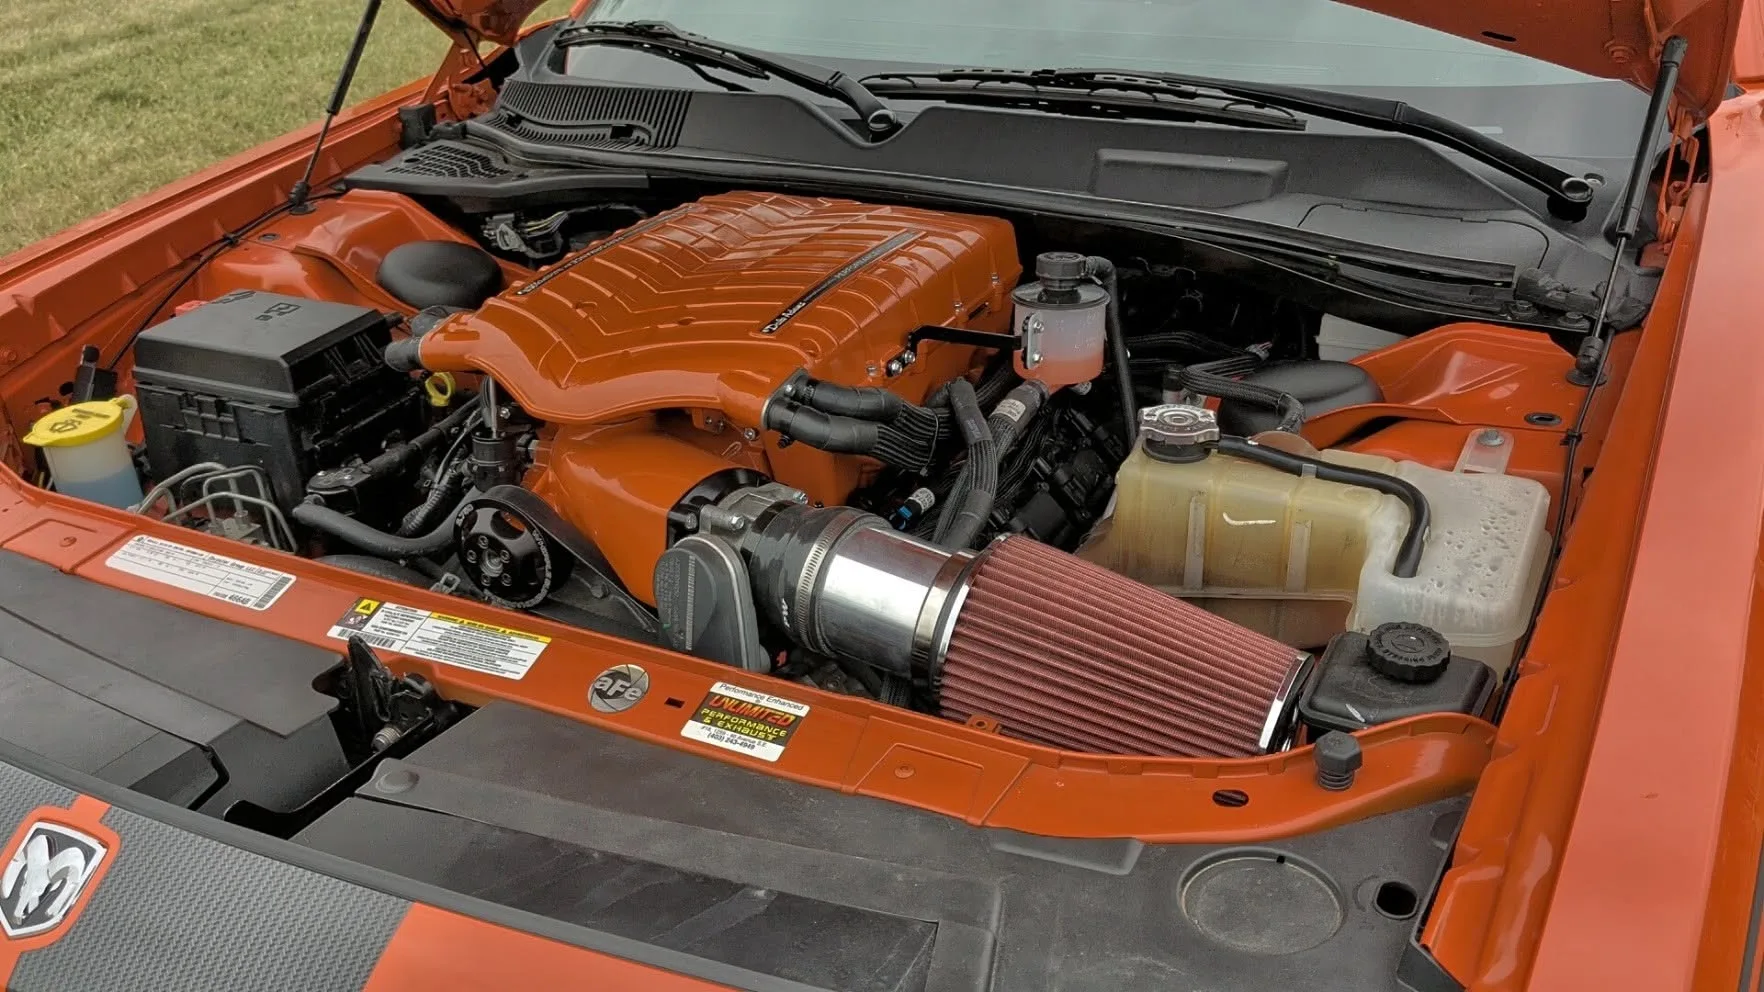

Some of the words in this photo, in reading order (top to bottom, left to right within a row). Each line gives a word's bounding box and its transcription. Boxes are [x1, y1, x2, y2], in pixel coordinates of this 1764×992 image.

[708, 694, 797, 727] UNLIMITED
[719, 683, 765, 700] Performance
[766, 696, 805, 711] Enhanced
[701, 708, 788, 737] PERFORMANCE
[717, 719, 777, 741] EXHAUST
